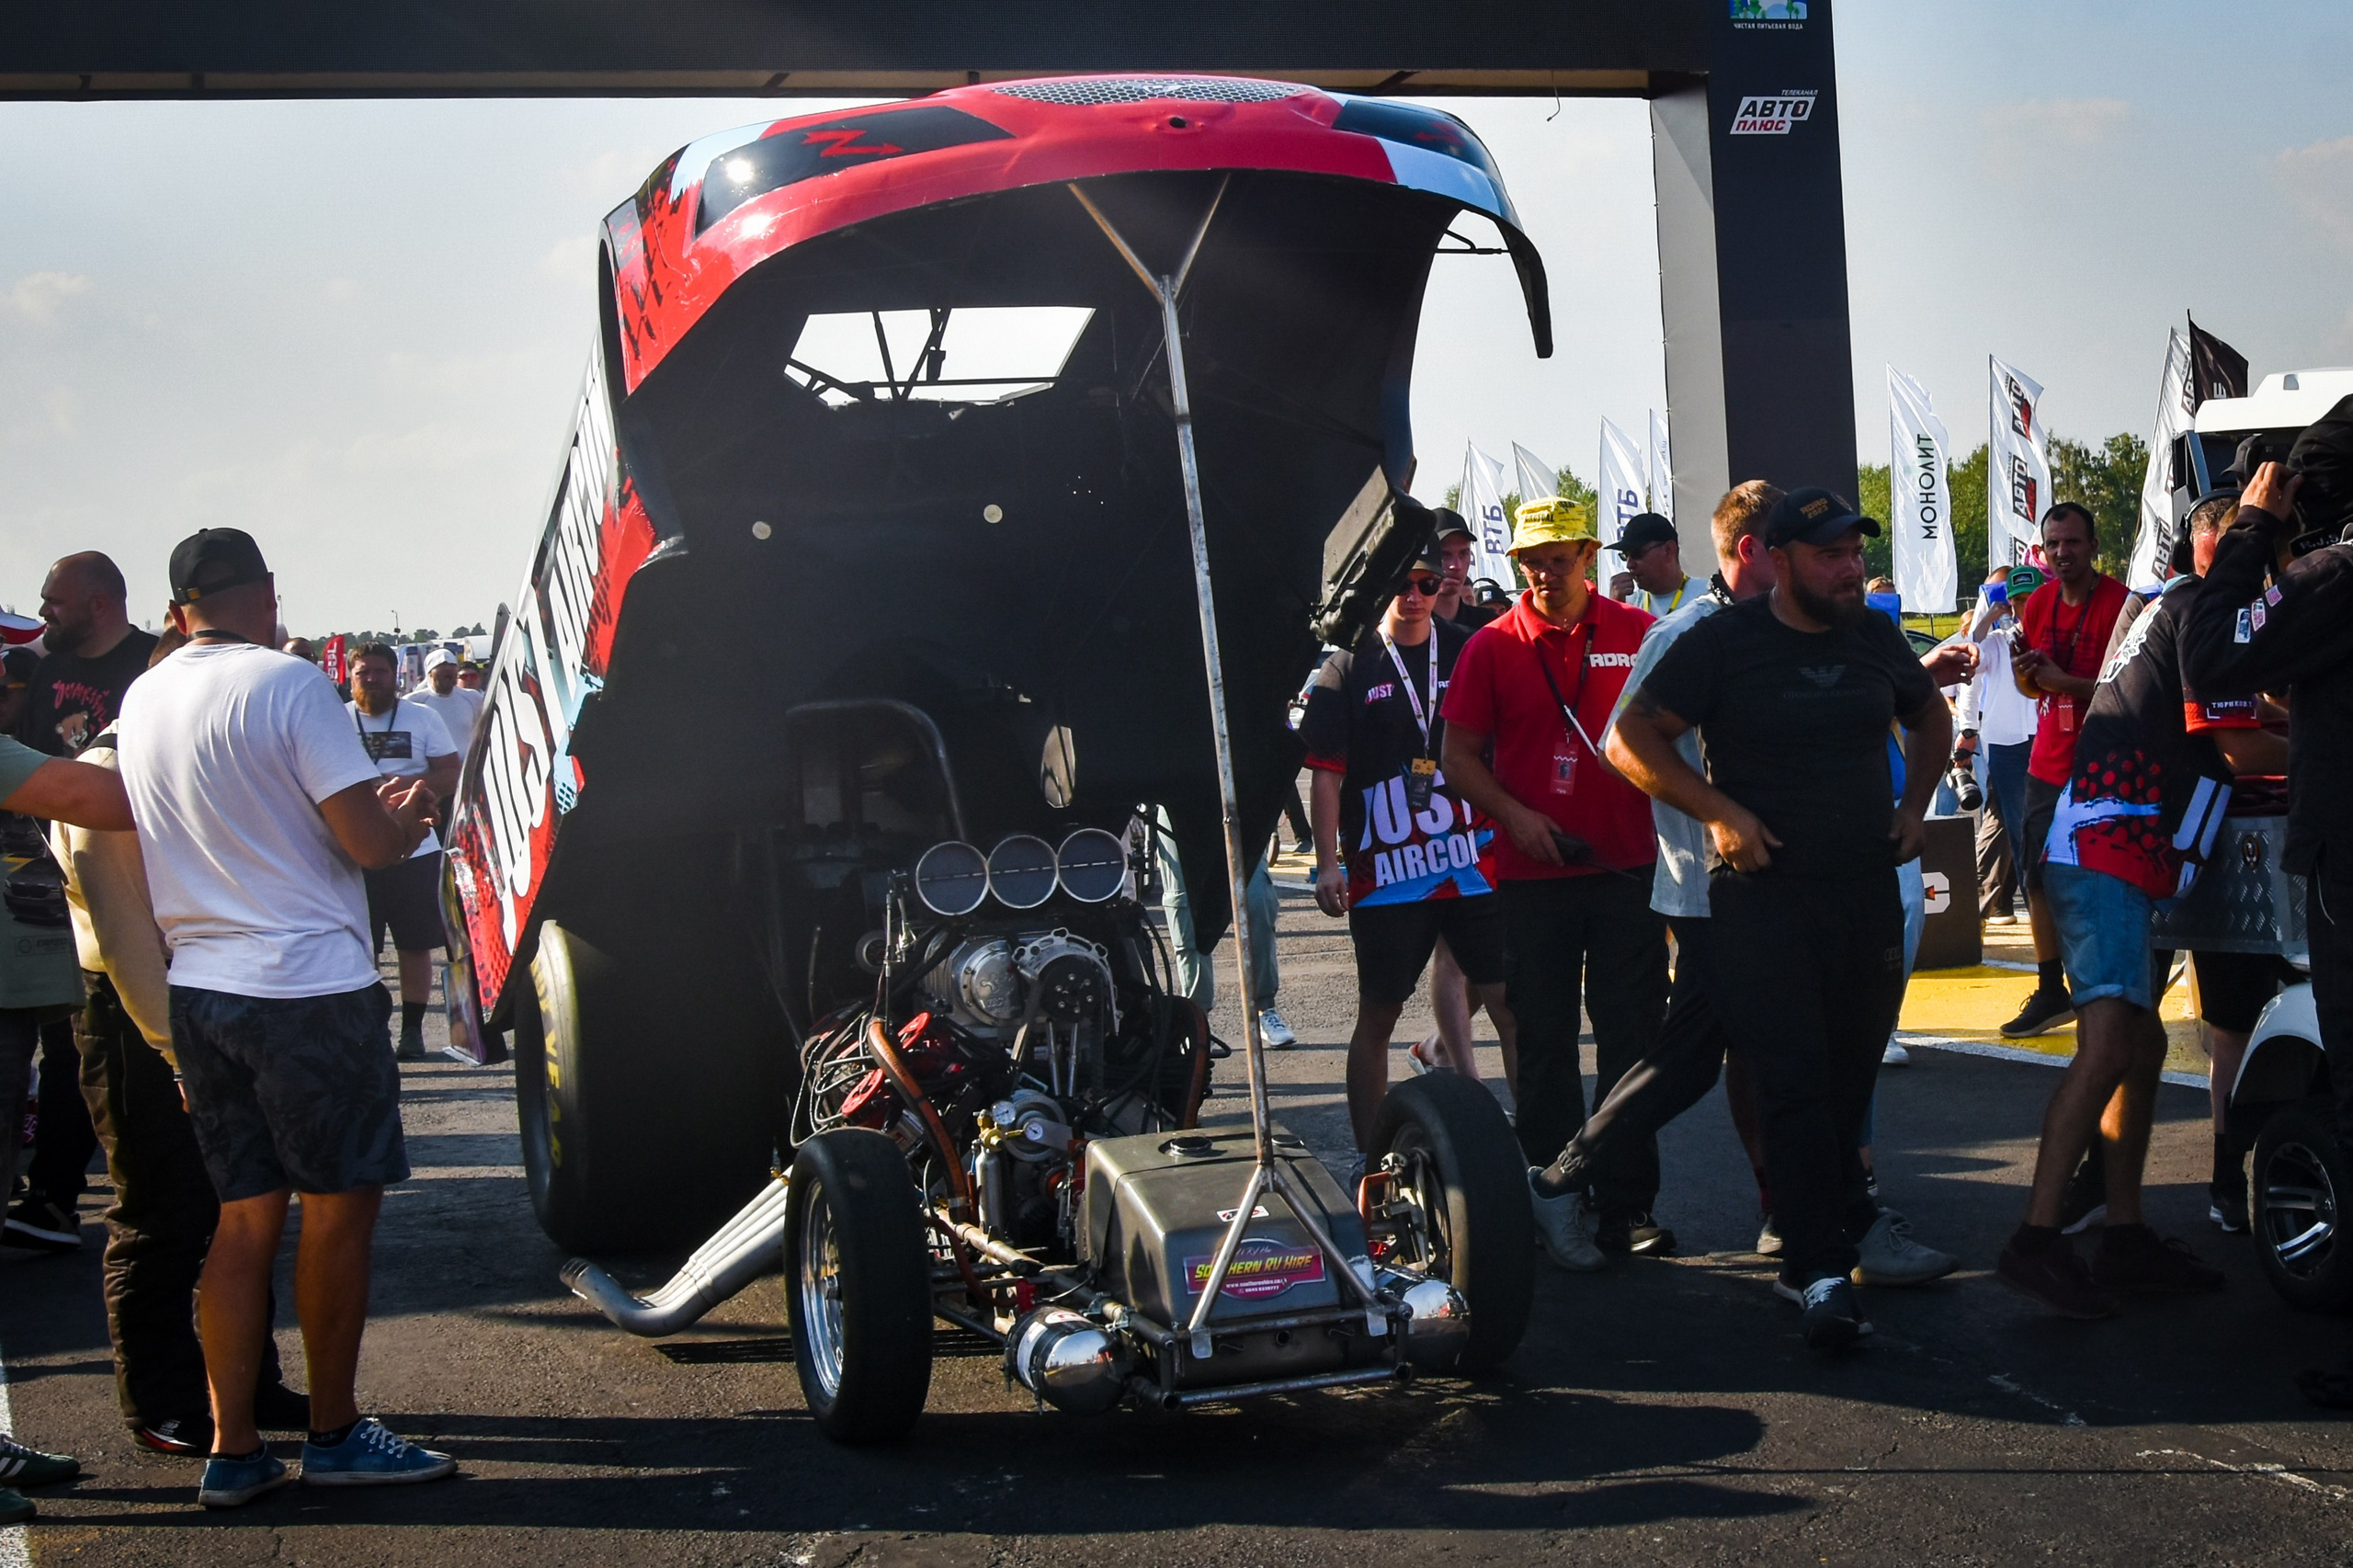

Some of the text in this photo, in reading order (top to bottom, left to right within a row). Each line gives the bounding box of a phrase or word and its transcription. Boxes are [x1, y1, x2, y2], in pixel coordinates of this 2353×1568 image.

[1735, 120, 1786, 131] ПЛЮС
[1740, 100, 1809, 118] АВТО
[1917, 434, 1938, 539] МОНОЛИТ
[2015, 460, 2028, 517] АВТО
[1483, 506, 1505, 554] ВТБ
[1366, 685, 1392, 702] JUST
[483, 536, 567, 956] JUST
[1195, 1260, 1263, 1278] SOHERN
